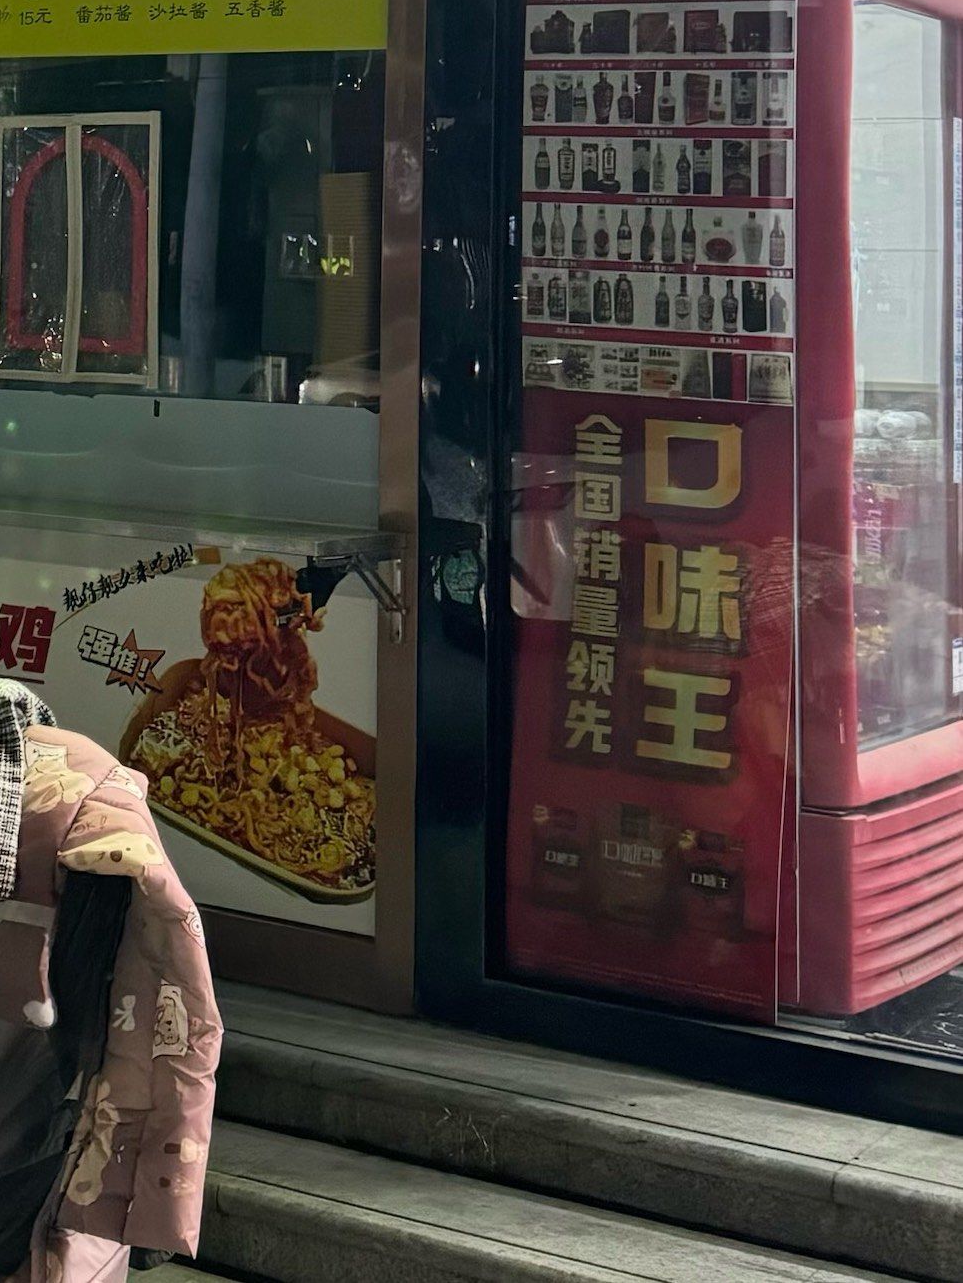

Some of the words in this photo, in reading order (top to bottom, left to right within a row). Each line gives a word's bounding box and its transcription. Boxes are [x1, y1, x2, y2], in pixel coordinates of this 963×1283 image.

[20, 8, 53, 25] 15元
[76, 5, 132, 24] 番茄酱
[148, 2, 209, 21] 沙拉酱
[225, 0, 287, 18] 五香酱
[564, 414, 623, 754] 全国销量领先
[636, 418, 743, 769] 口味王
[77, 625, 150, 681] 强推!
